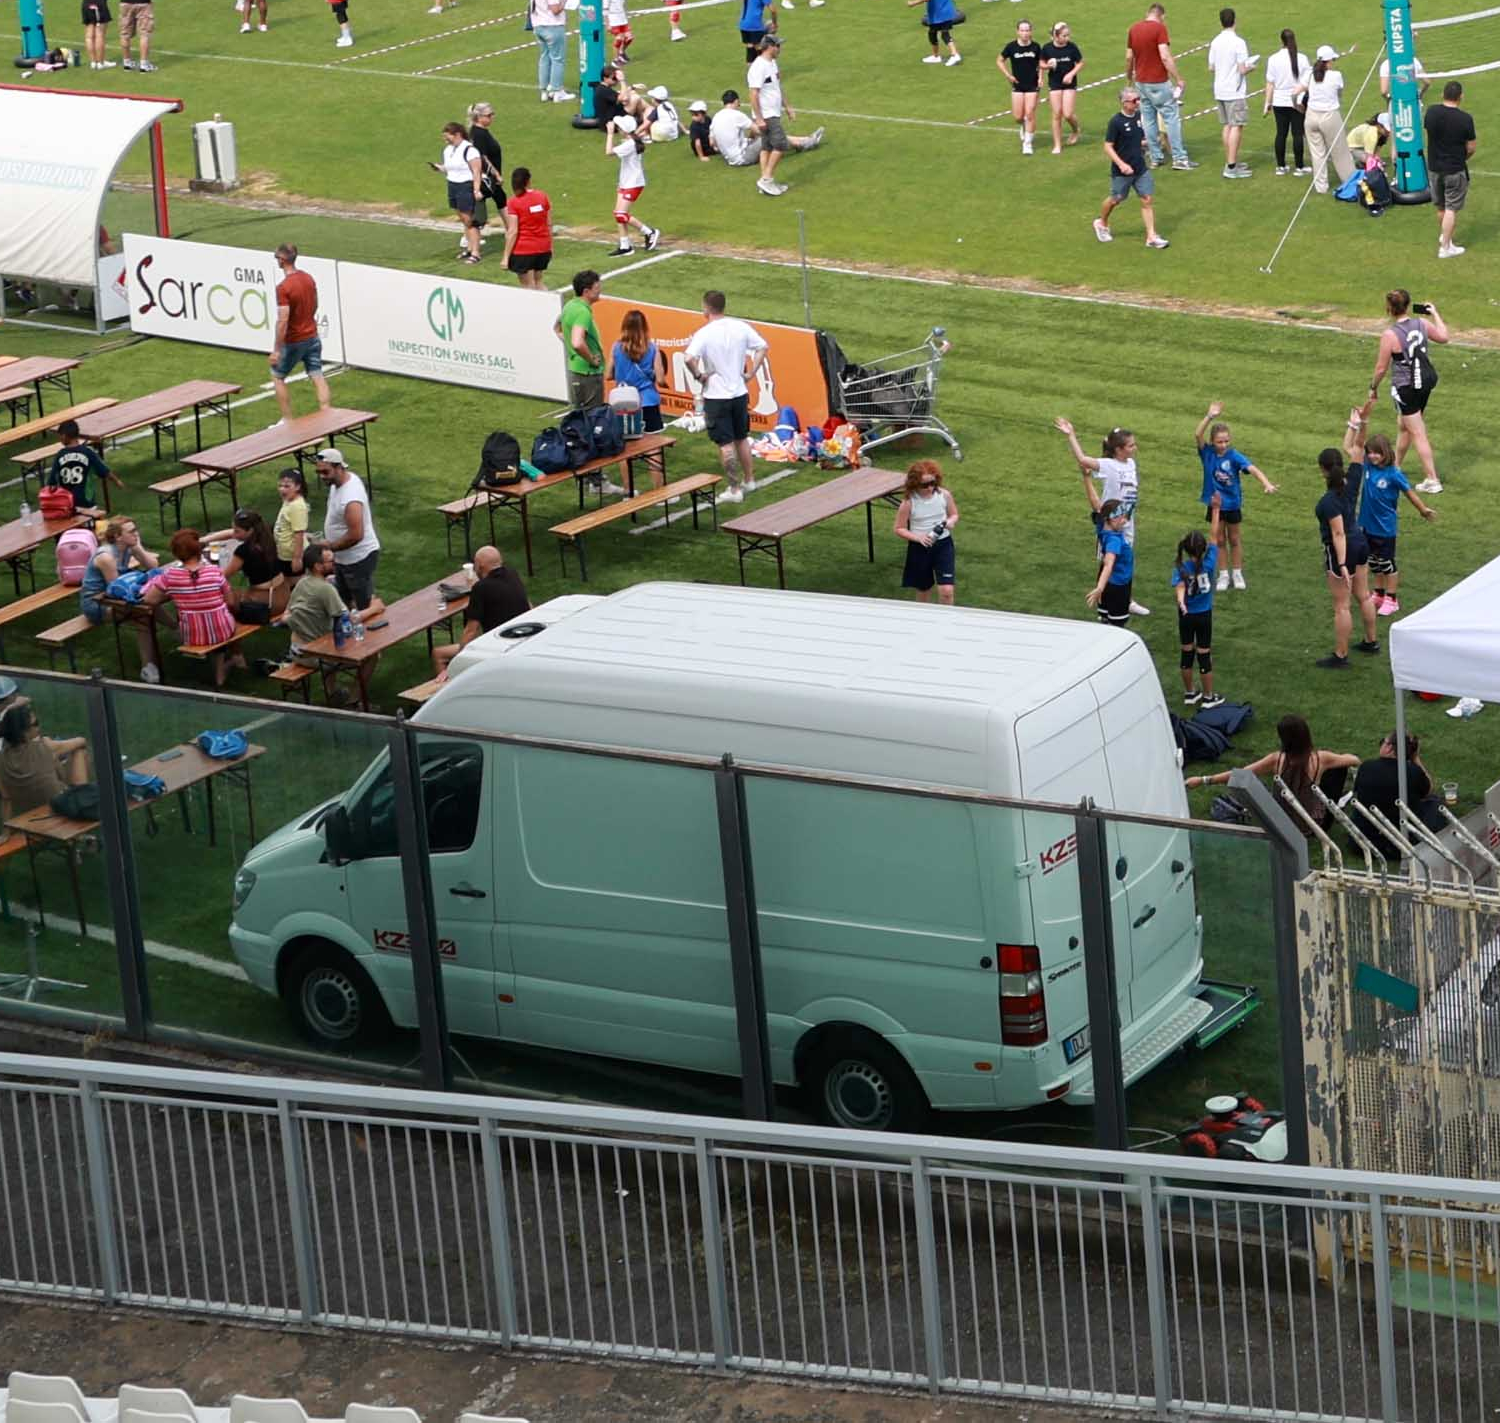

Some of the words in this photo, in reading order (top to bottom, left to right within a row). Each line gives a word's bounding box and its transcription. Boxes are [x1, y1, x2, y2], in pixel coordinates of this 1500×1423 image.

[1390, 8, 1404, 54] KIPSTA
[137, 254, 269, 331] Sarca
[234, 267, 265, 285] GMA
[388, 338, 451, 360] INSPECTION
[452, 349, 485, 366] SWISS
[486, 354, 515, 371] SAGL
